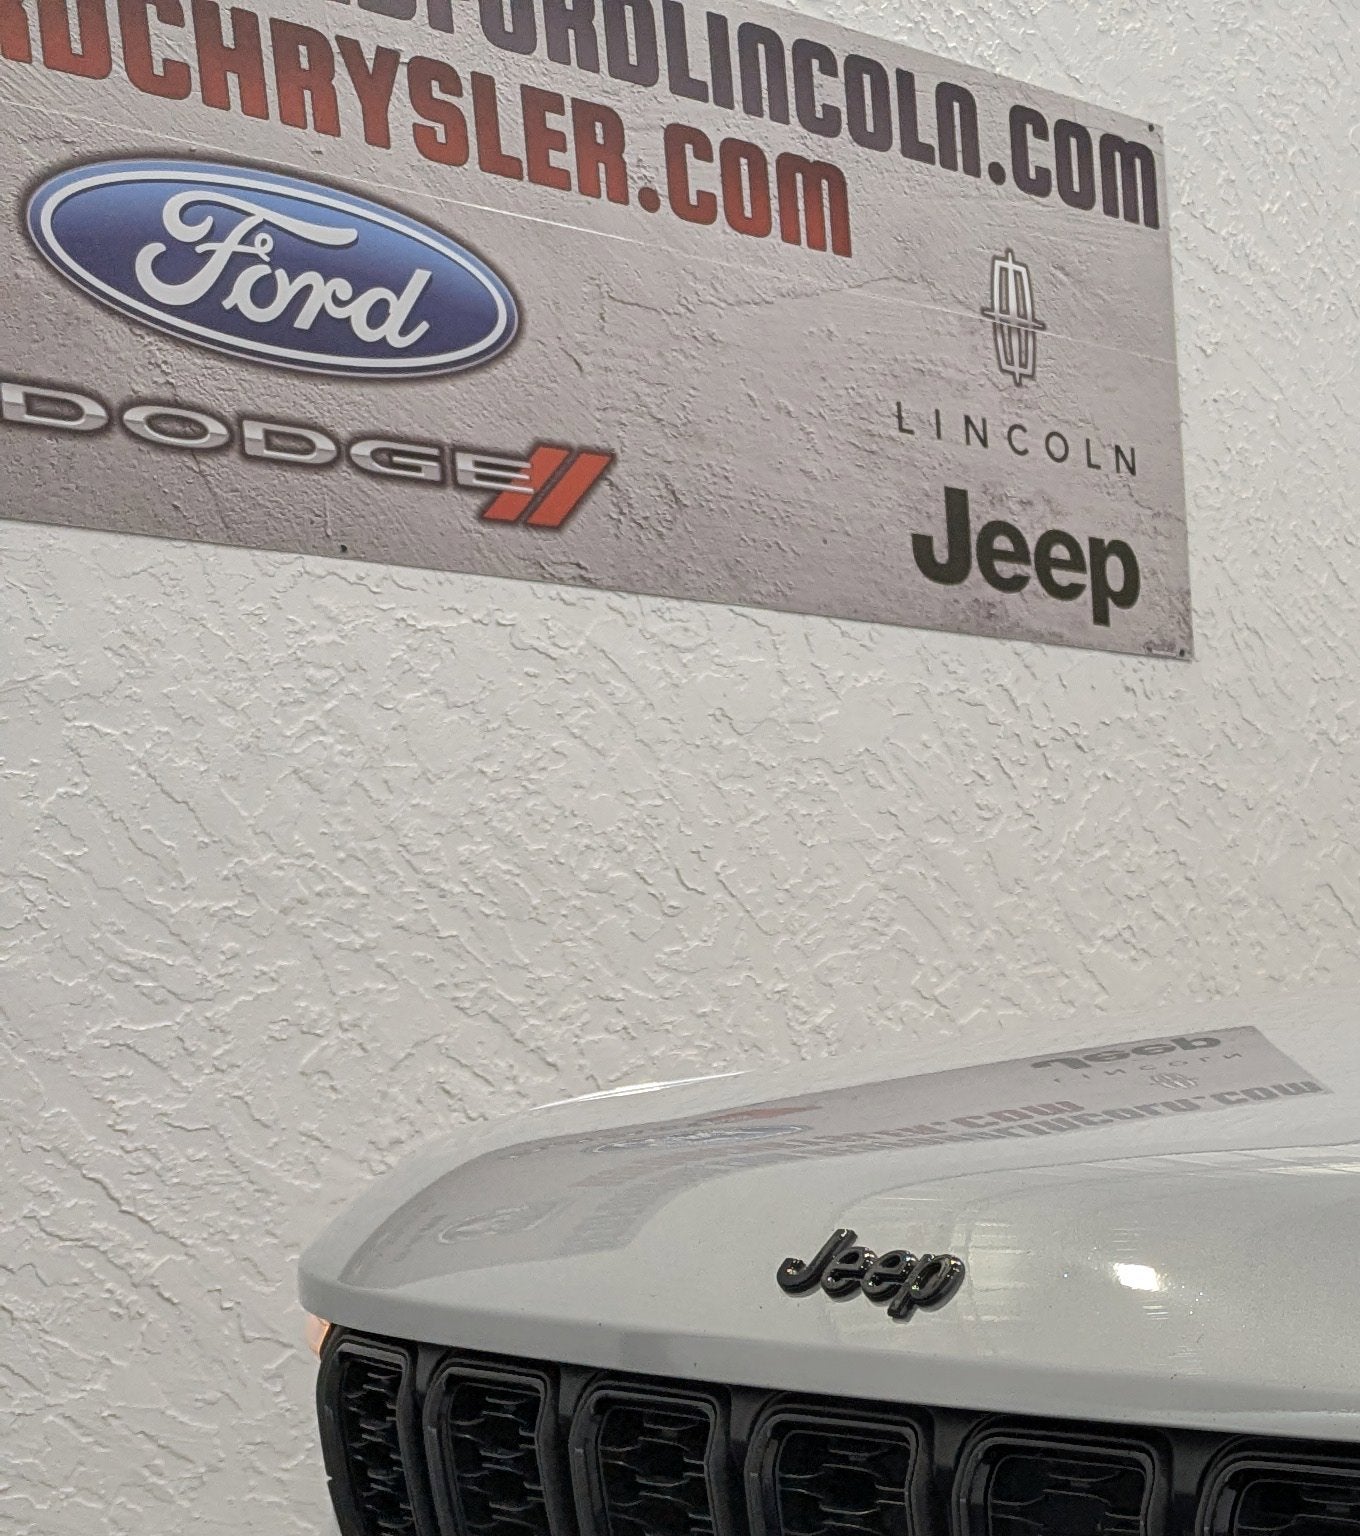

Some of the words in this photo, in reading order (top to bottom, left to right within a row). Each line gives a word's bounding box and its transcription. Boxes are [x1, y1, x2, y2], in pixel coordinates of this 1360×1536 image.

[135, 190, 432, 348] Ford
[0, 383, 535, 496] DODGE
[896, 401, 1137, 477] LINCOLN
[911, 486, 1141, 628] Jeep
[776, 1229, 966, 1324] Jeep
